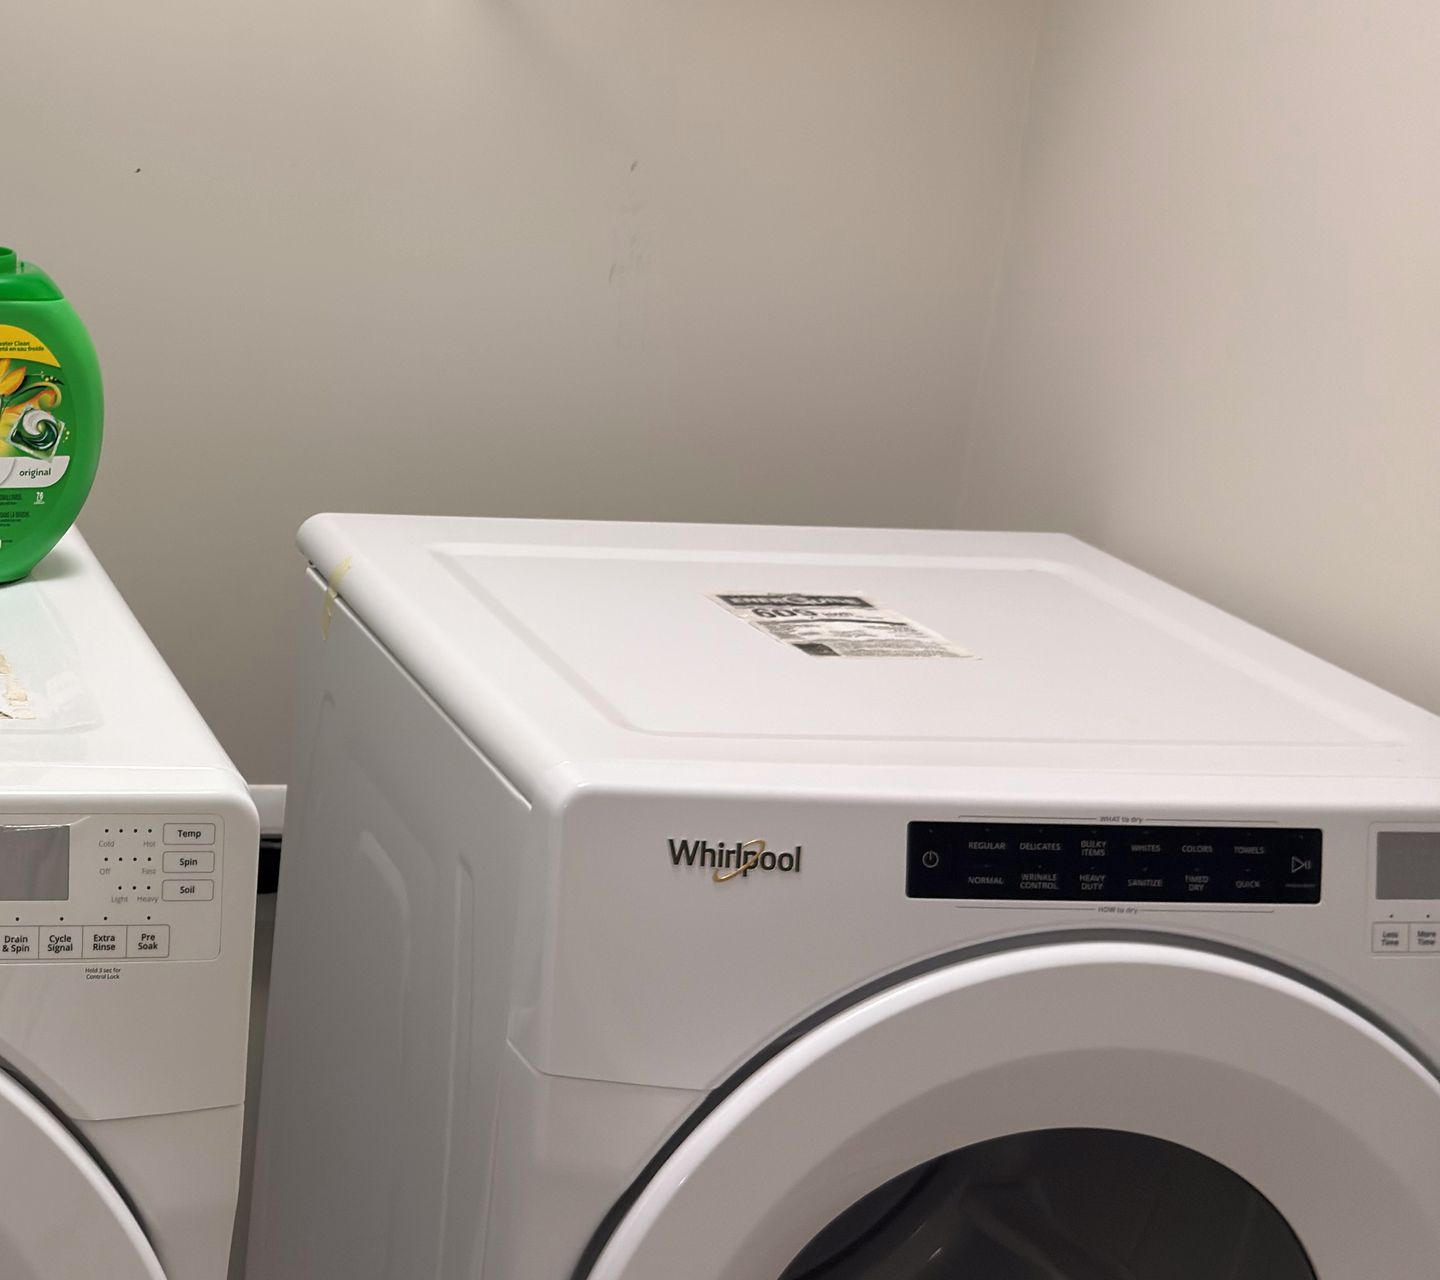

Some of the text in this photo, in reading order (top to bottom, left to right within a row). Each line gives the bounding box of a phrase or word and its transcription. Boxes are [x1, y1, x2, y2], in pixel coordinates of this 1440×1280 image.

[19, 468, 52, 479] original
[177, 829, 202, 839] Temp
[98, 840, 115, 848] Cold
[968, 841, 1006, 850] REGULAR
[1019, 842, 1061, 851] DELICATES
[1080, 840, 1107, 848] BULKY
[1081, 848, 1106, 857] ITEMS
[179, 857, 198, 868] Spin
[668, 837, 803, 879] Whirlpool
[968, 876, 1004, 885] NORMAL
[1079, 874, 1106, 882] HEAVY
[179, 886, 195, 894] Soil
[1019, 881, 1059, 890] CONTROL
[1081, 882, 1103, 891] DUTY
[137, 896, 159, 904] Heavy
[4, 935, 28, 943] Drain
[49, 934, 72, 944] Cycle
[93, 934, 116, 943] Extra
[141, 933, 156, 942] Pre
[2, 945, 30, 954] & Spin
[47, 943, 73, 954] Signal
[92, 943, 116, 951] Rinse
[137, 942, 158, 951] Soak
